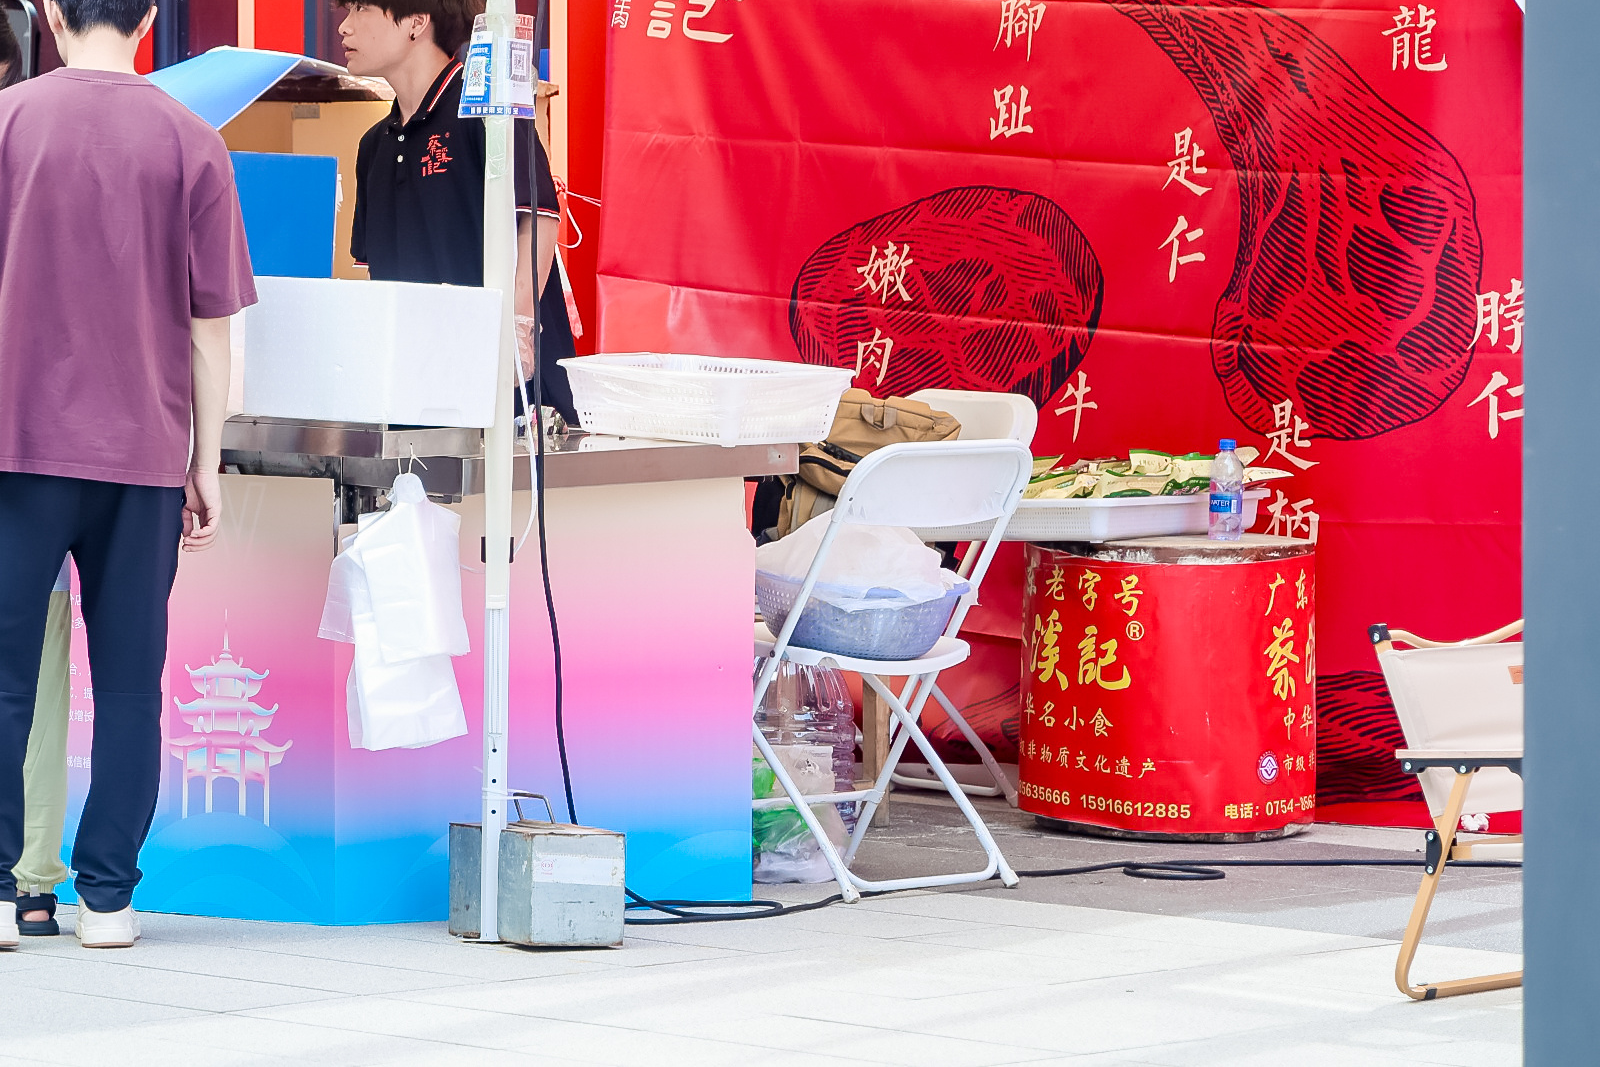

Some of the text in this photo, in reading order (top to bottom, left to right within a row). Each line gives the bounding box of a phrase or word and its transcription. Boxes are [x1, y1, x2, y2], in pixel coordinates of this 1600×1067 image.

[1157, 126, 1213, 284] 匙仁
[853, 240, 914, 387] 嫩肉
[1054, 369, 1098, 444] 牛
[1262, 398, 1320, 545] 匙柄
[1264, 568, 1315, 617] 广东
[1022, 608, 1132, 692] 溪記
[1019, 692, 1114, 738] 华名小食
[1283, 704, 1314, 741] 中华
[1080, 794, 1192, 819] 15916612885
